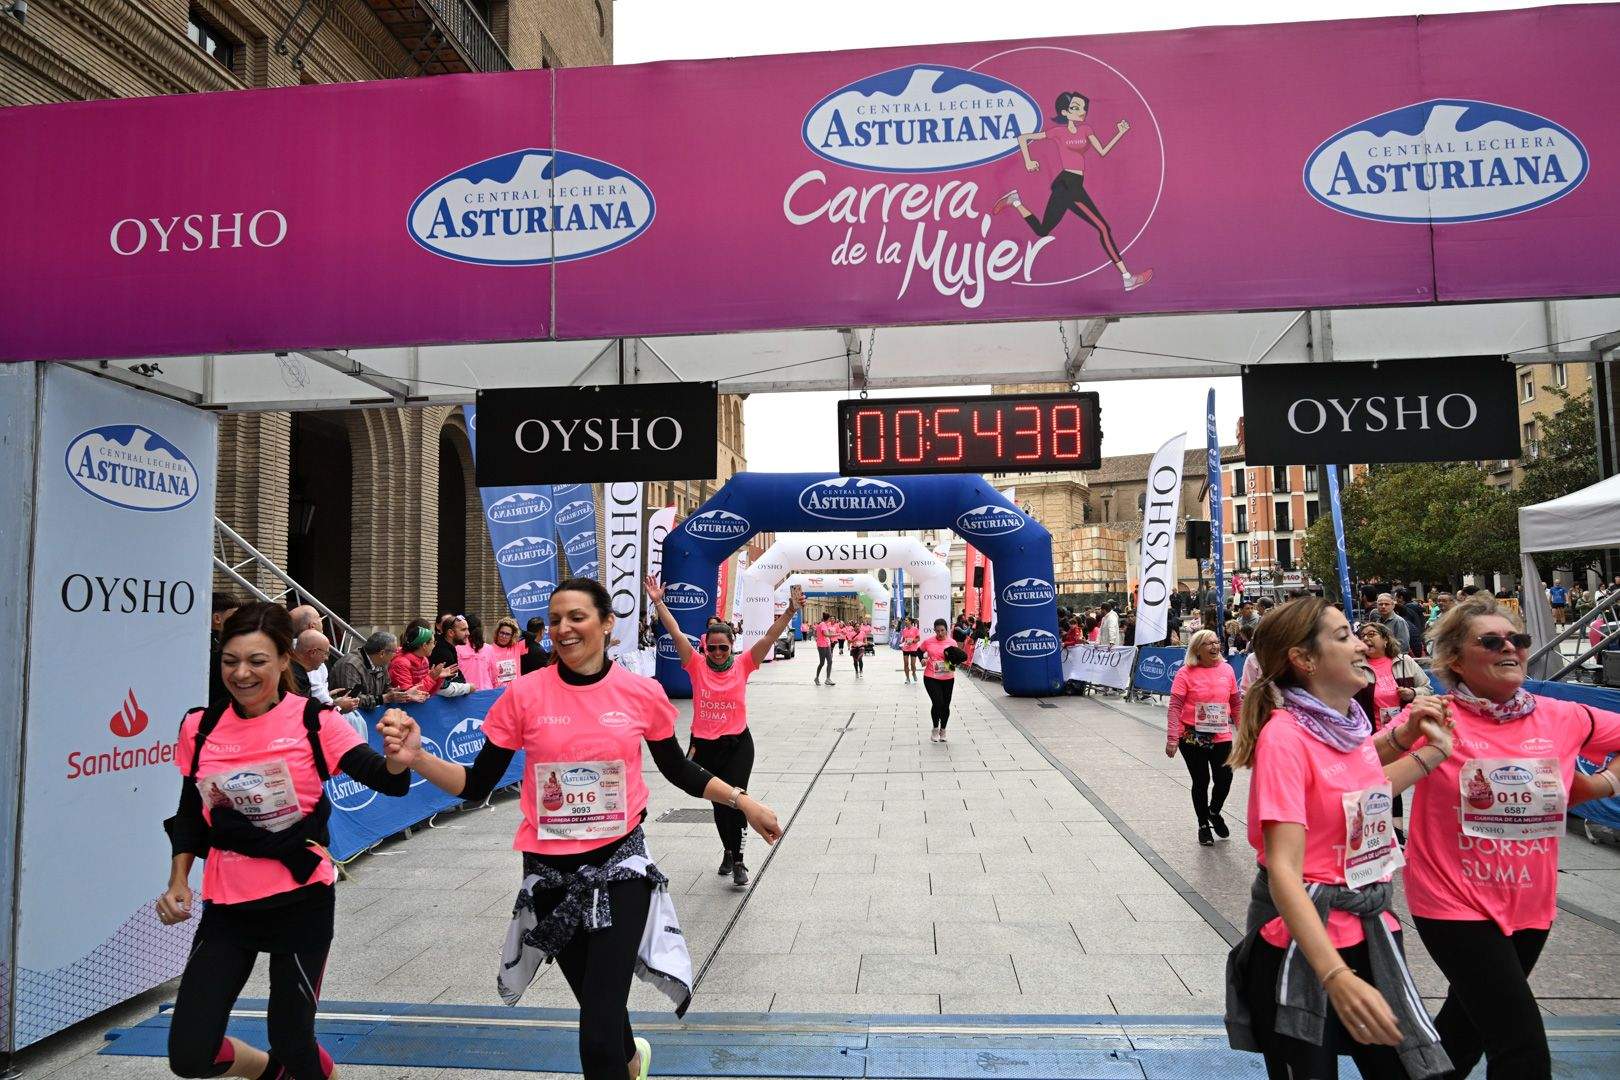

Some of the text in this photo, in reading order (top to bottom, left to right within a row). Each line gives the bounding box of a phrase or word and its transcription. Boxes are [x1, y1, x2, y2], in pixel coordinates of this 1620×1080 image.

[857, 98, 1016, 115] CENTRAL LECHERA
[820, 108, 1022, 148] ASTURIANA
[1368, 136, 1556, 158] CENTRAL LECHERA
[1326, 151, 1567, 195] ASTURIANA
[463, 184, 628, 204] CENTRAL LECHERA
[783, 169, 980, 226] Carrera
[426, 197, 636, 240] ASTURIANA
[110, 209, 288, 256] OYSHO
[831, 212, 1055, 309] de la Mujer
[1287, 393, 1478, 435] OYSHO
[515, 416, 683, 454] OYSHO
[99, 446, 187, 472] CENTRAL LECHERA
[76, 444, 191, 497] ASTURIANA
[807, 491, 897, 510] ASTURIANA
[689, 520, 745, 532] ASTURIANA
[962, 517, 1020, 529] ASTURIANA
[1142, 465, 1178, 607] OYSHO
[611, 481, 638, 618] OYSHO
[806, 543, 887, 562] OYSHO
[61, 573, 195, 615] OYSHO
[1006, 589, 1052, 601] ASTURIANA
[1009, 639, 1056, 651] ASTURIANA
[1082, 649, 1122, 668] OYSHO
[700, 700, 736, 710] DORSAL
[700, 710, 727, 720] SUMA
[67, 739, 180, 780] Santander
[234, 794, 264, 806] 016
[566, 791, 596, 804] 016
[1497, 792, 1532, 804] 016
[572, 806, 591, 814] 9093
[1504, 806, 1527, 814] 6587
[1363, 820, 1386, 837] 016
[1472, 825, 1505, 834] OYSHO
[1461, 858, 1533, 884] SUMA
